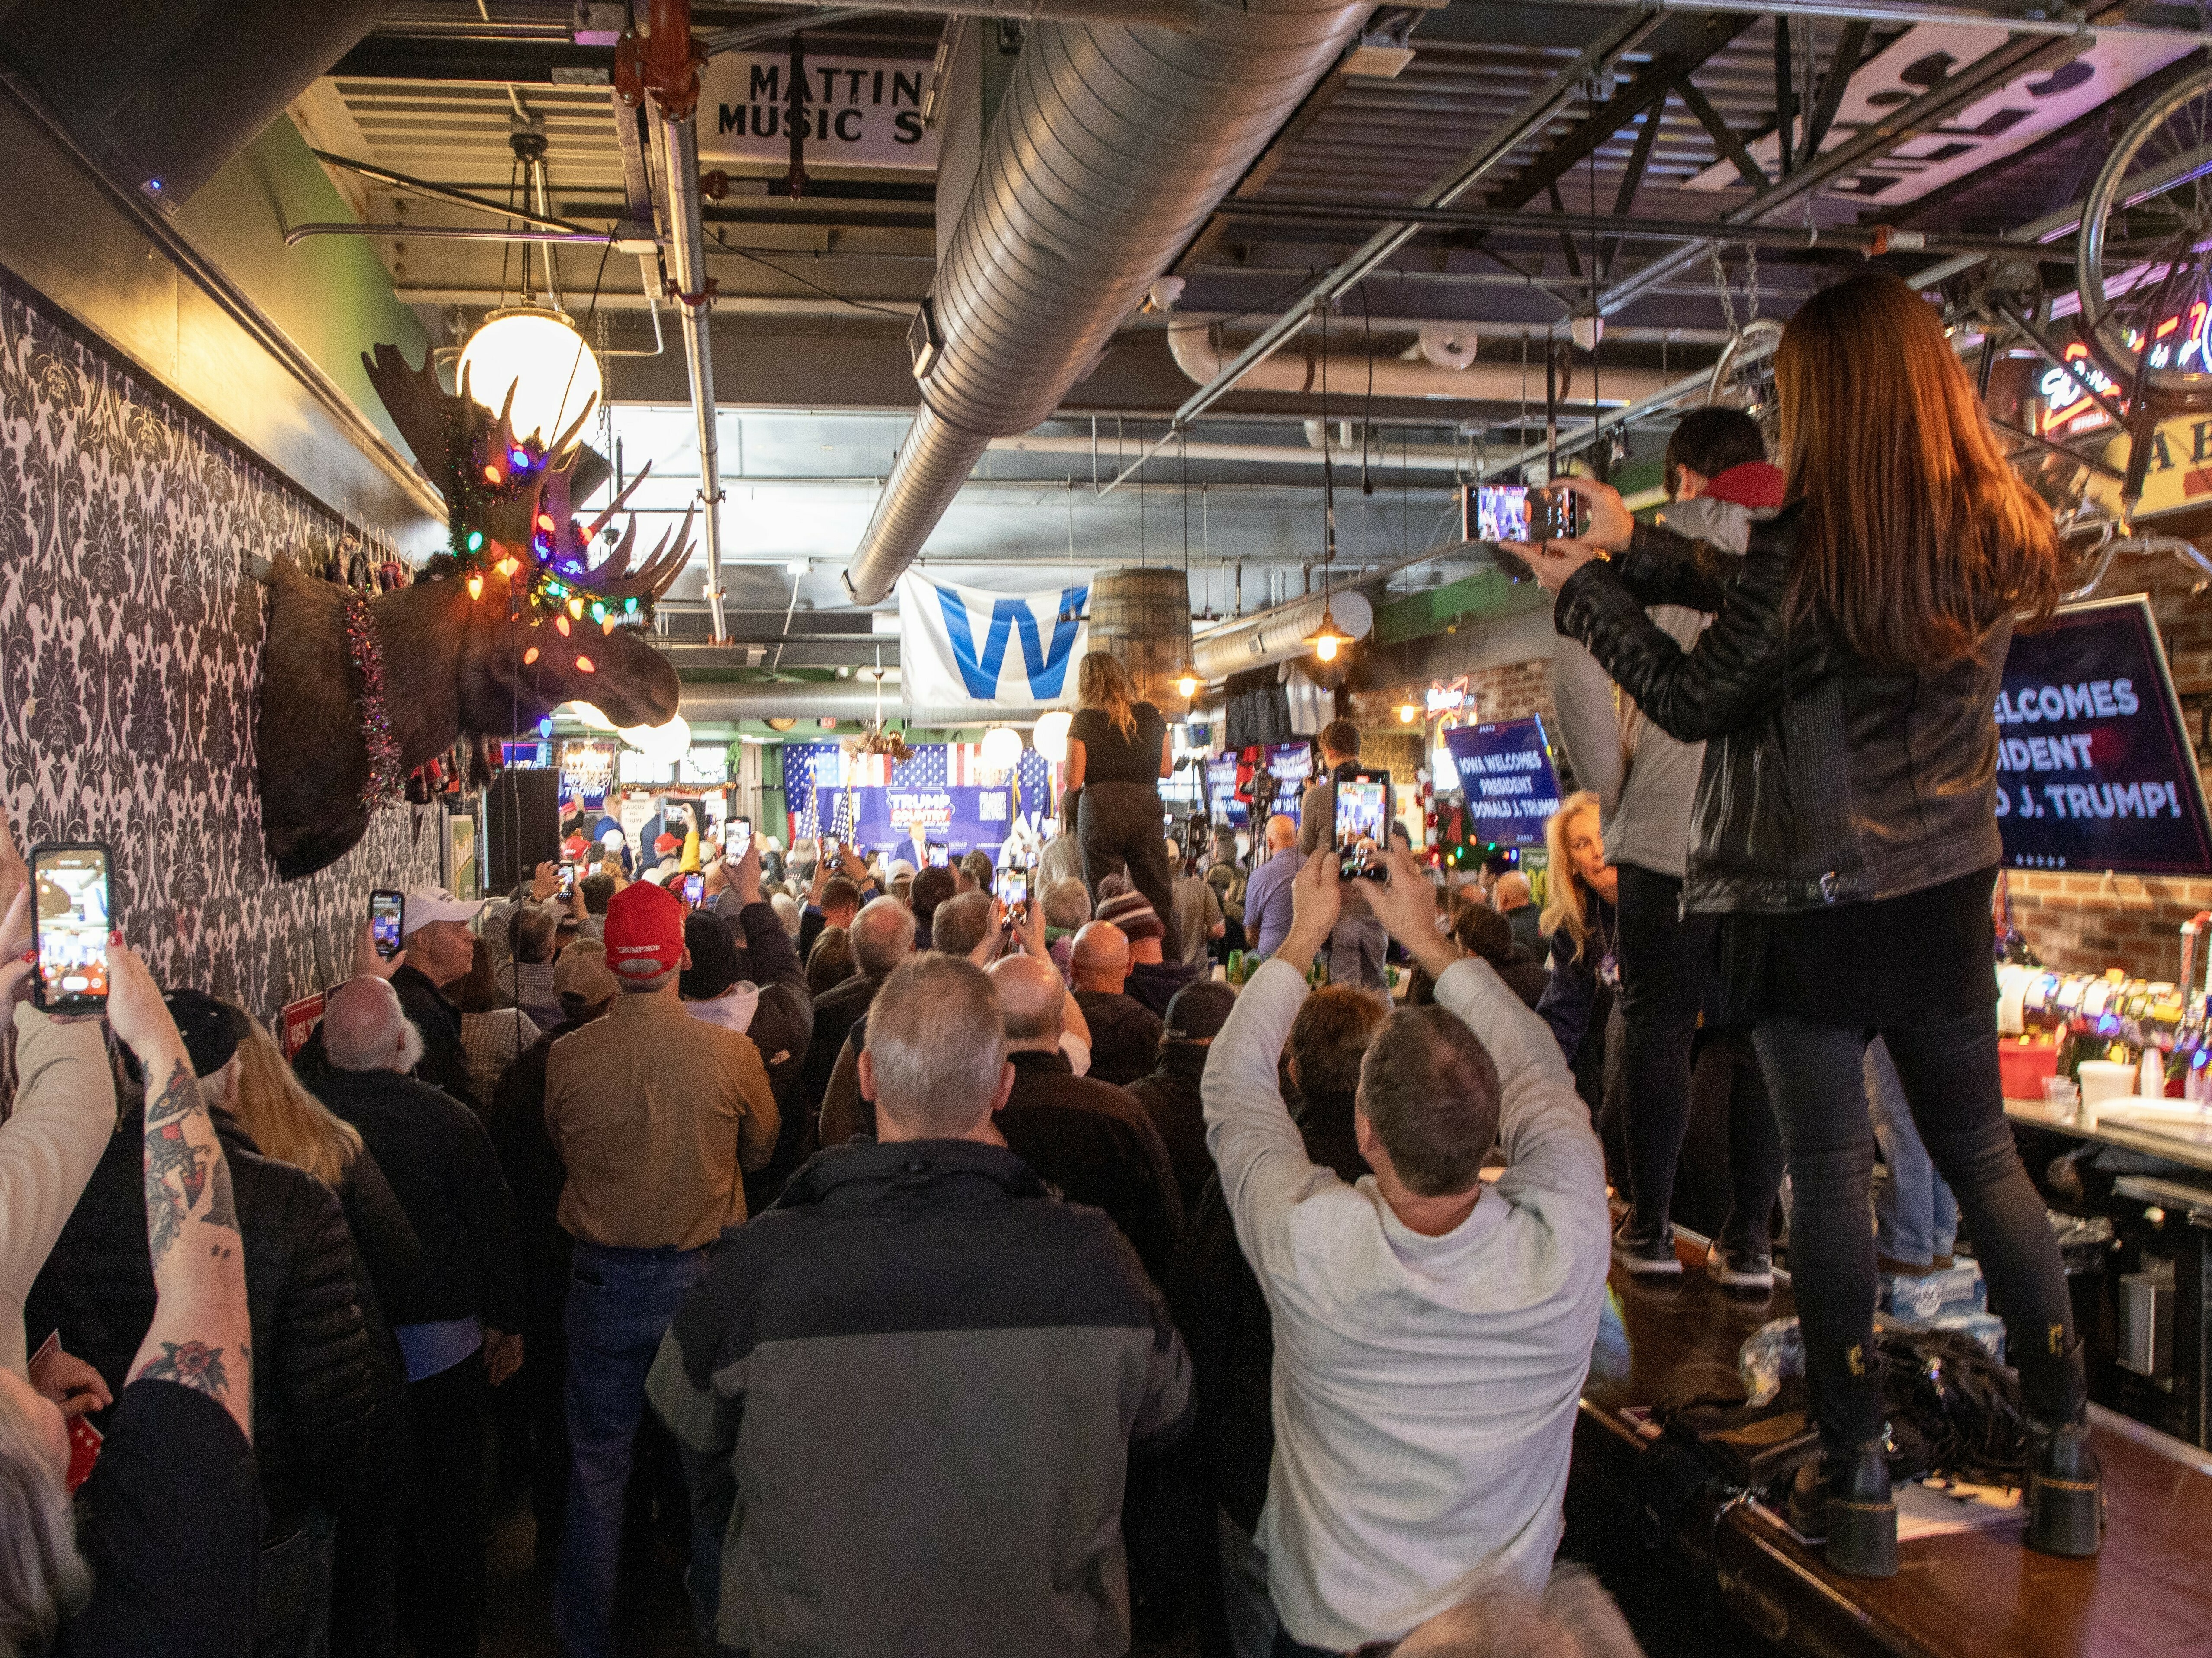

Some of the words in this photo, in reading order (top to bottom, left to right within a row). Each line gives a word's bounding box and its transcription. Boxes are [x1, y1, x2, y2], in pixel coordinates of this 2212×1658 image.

[750, 65, 922, 106] MATTIN
[935, 586, 1089, 700] W
[1484, 750, 1542, 772] WELCOMES
[1995, 733, 2093, 771] IDENT
[1480, 775, 1533, 796] PRESIDENT
[2019, 784, 2045, 818] J.
[2044, 781, 2181, 818] TRUMP!
[890, 794, 951, 810] TRUMP
[1472, 800, 1512, 818] DONALD
